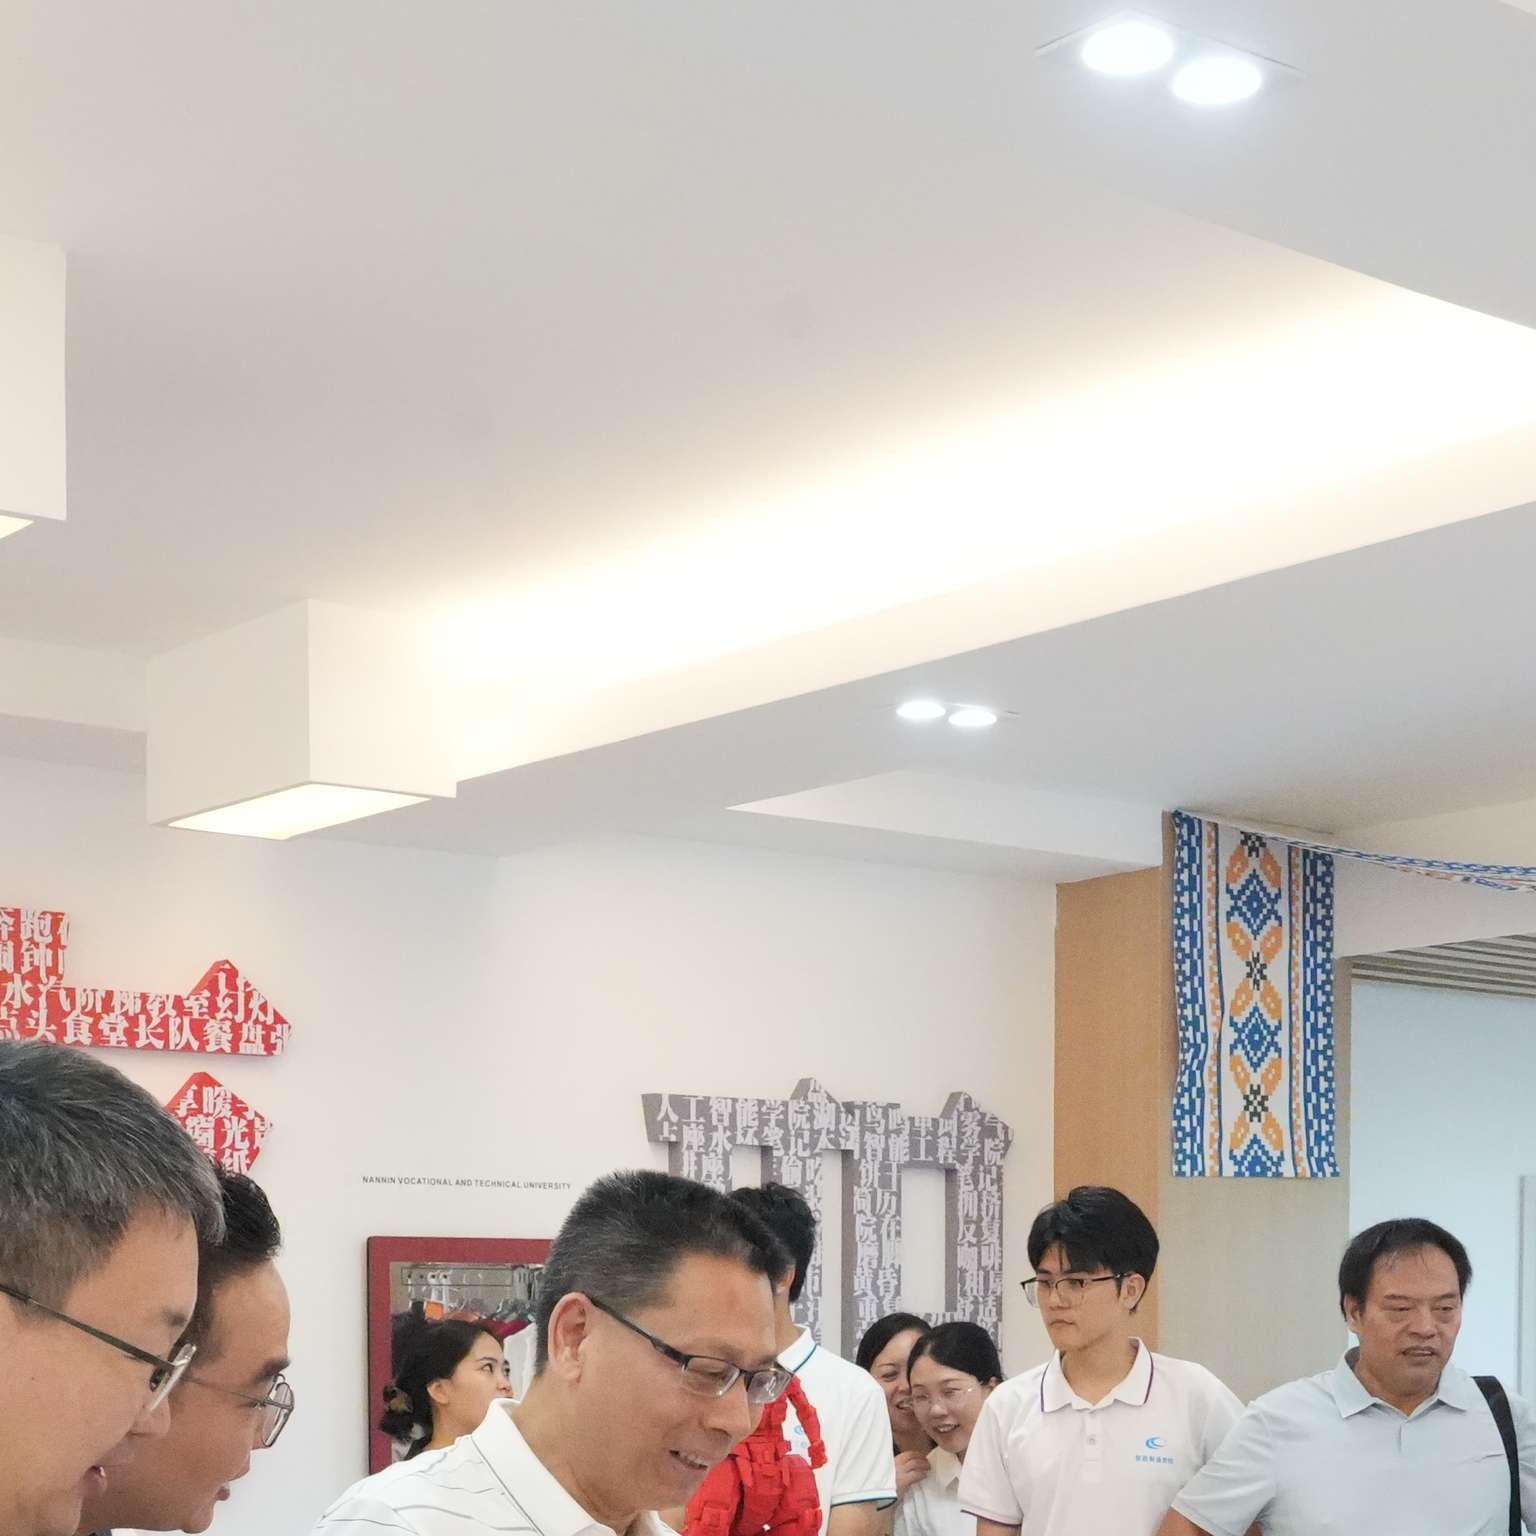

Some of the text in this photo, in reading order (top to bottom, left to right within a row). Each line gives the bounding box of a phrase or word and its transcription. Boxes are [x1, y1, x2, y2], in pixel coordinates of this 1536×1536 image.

[362, 1175, 572, 1190] NANNIN VOCATIONAL AND TECHNICAL UNIVERSITY
